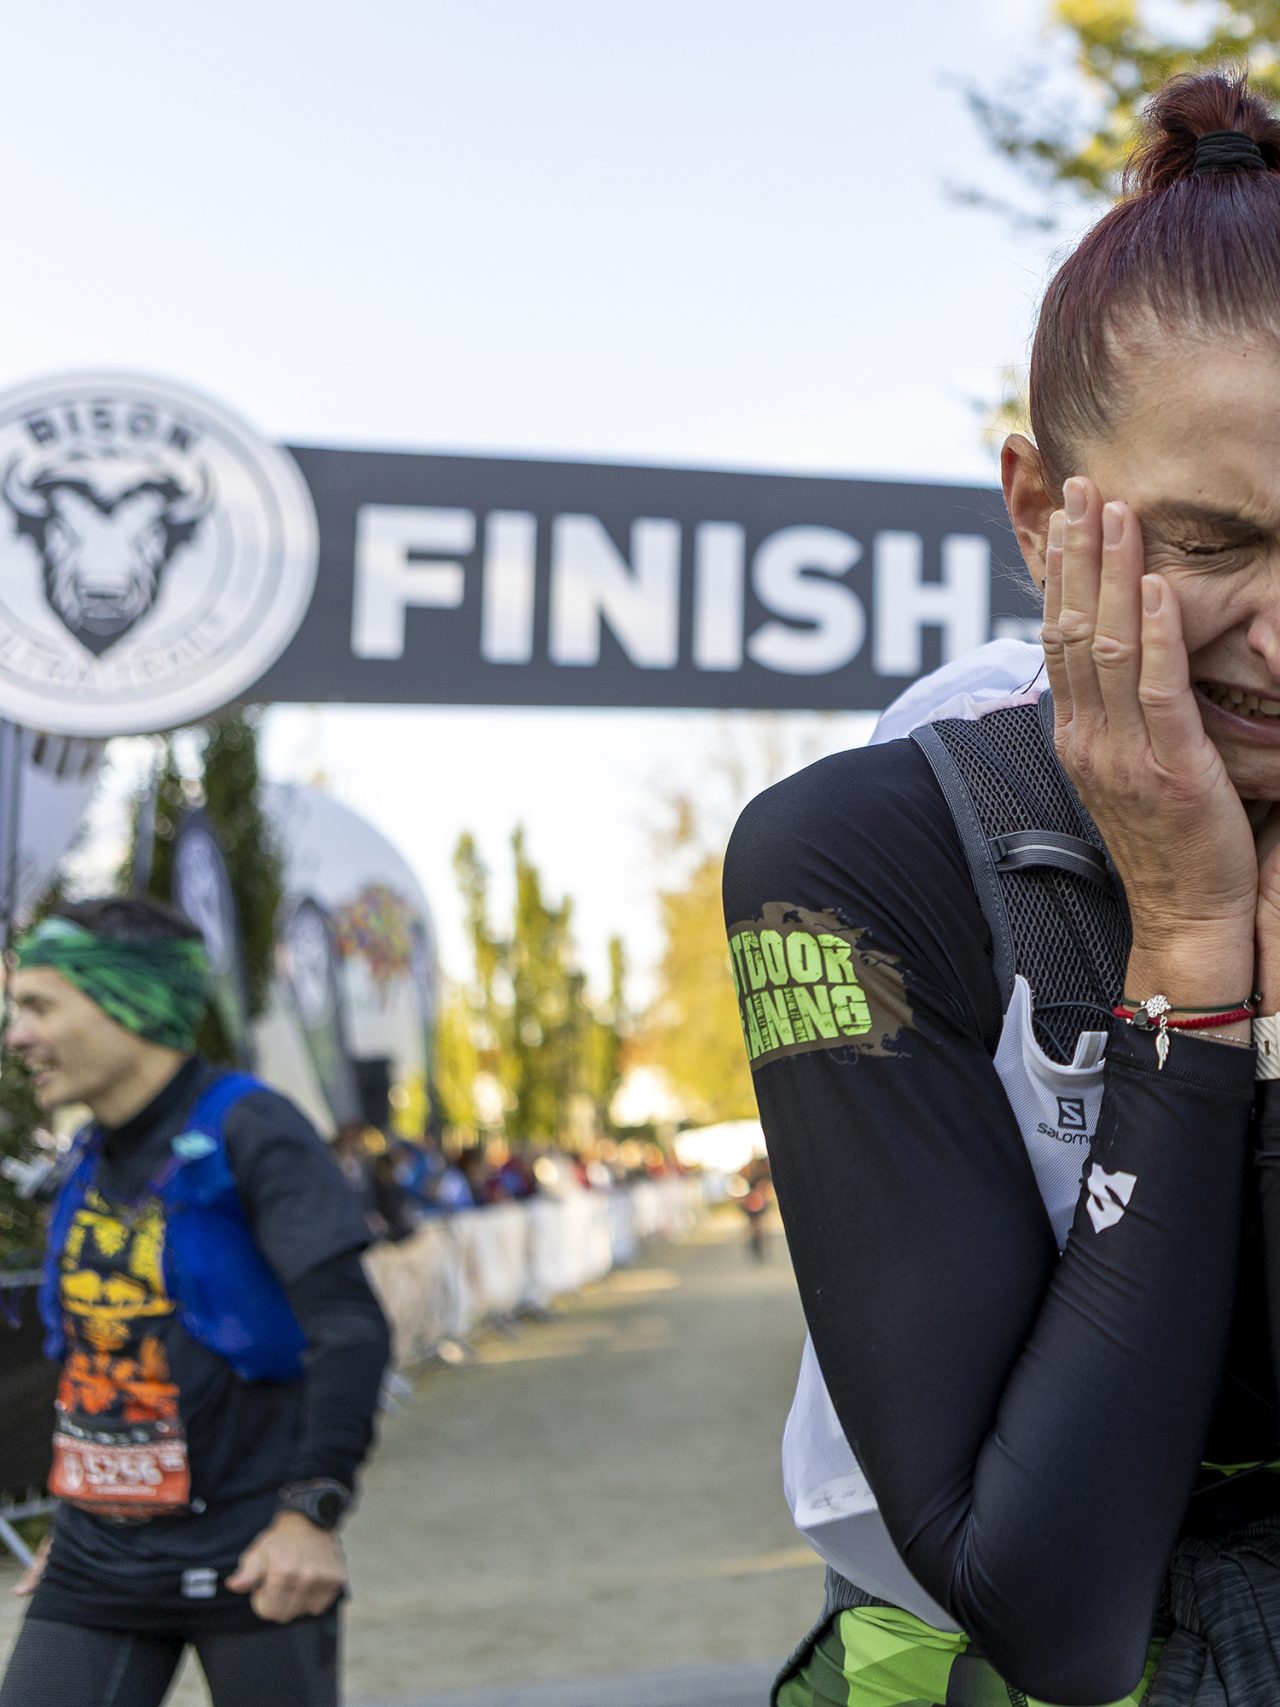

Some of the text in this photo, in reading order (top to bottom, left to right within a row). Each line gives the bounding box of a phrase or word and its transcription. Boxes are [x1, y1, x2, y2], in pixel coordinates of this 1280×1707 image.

[26, 399, 199, 451] BISON
[350, 502, 991, 677] FINISH
[729, 929, 859, 994] TDOOR
